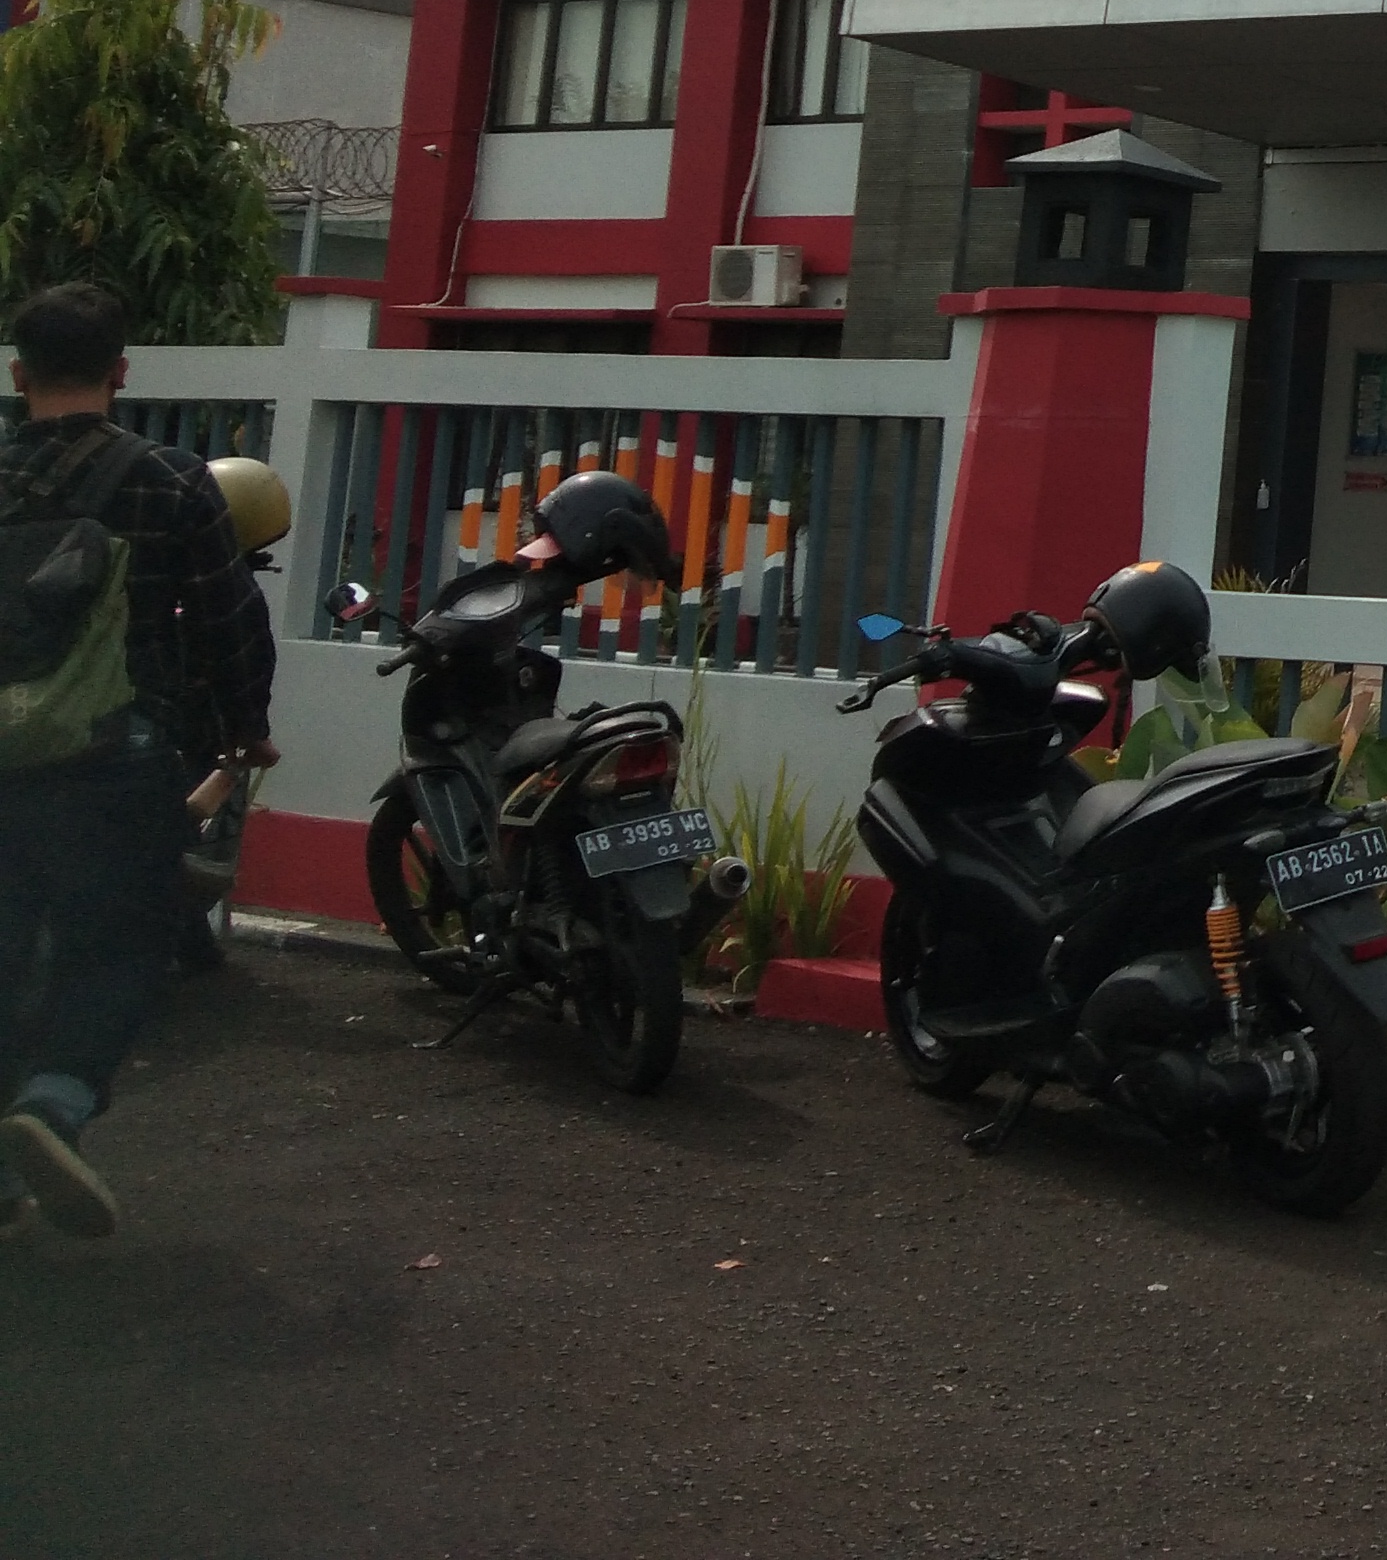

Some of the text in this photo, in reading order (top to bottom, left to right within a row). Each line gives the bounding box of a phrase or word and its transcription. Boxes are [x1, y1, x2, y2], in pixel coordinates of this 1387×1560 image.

[584, 813, 709, 855] AB 3935 WC
[1276, 833, 1384, 883] AB 2562 IA
